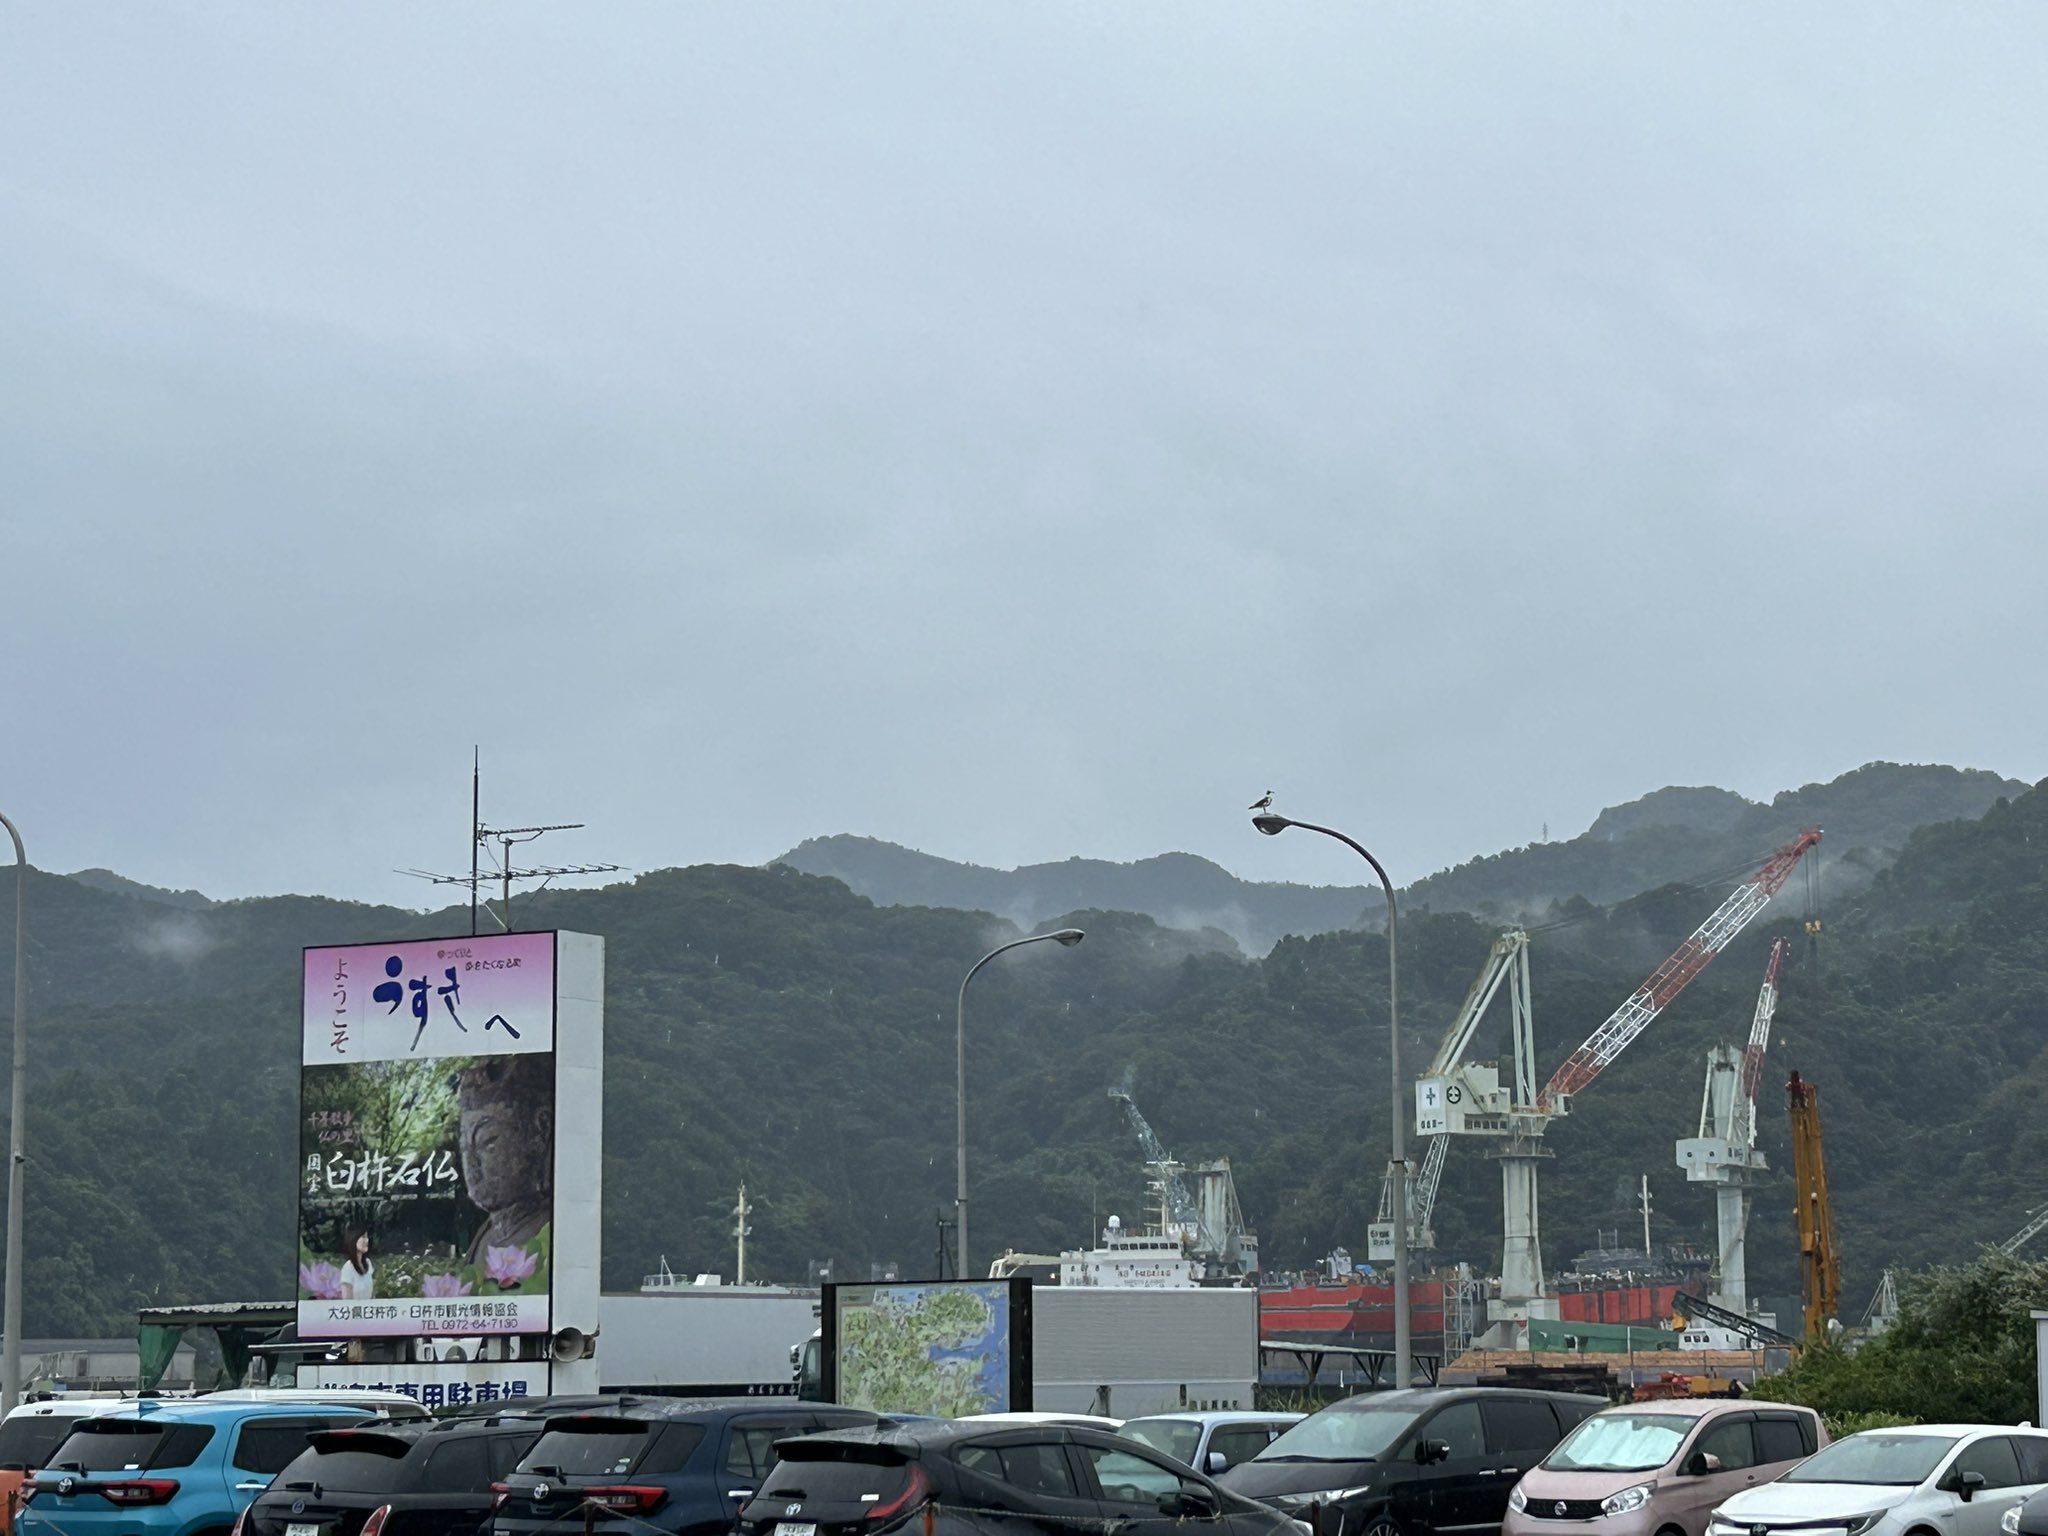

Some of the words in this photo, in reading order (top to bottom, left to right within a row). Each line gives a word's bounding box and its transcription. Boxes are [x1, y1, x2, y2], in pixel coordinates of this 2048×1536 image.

[330, 958, 350, 1054] ようこそ
[326, 1149, 459, 1192] 臼杵石仏
[422, 1320, 439, 1331] TEL
